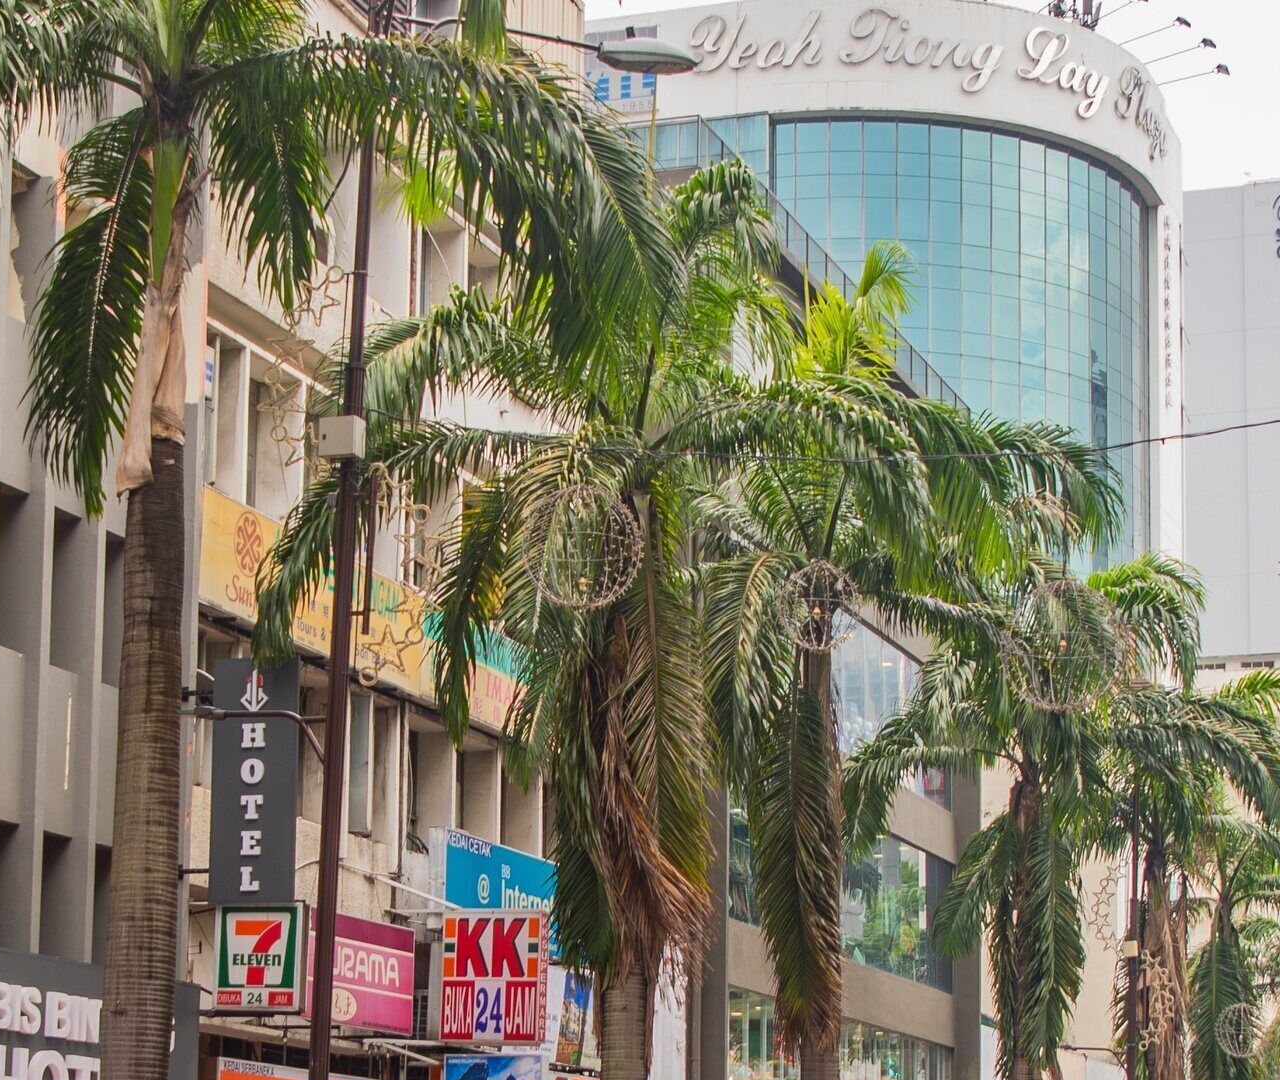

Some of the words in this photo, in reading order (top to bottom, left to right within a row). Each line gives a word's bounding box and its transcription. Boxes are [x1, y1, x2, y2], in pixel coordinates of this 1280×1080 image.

[687, 8, 824, 73] Yeoh
[839, 7, 1004, 93] Tiong
[1017, 26, 1110, 120] Lay
[239, 722, 266, 893] HOTEL
[446, 829, 468, 851] KEDAI
[468, 837, 492, 858] CETAK
[501, 863, 511, 880] BB
[455, 916, 528, 978] KK
[246, 992, 263, 1007] 24
[273, 994, 288, 1005] JAM
[443, 984, 474, 1040] BUKA
[474, 985, 503, 1035] 24
[504, 985, 536, 1040] JAM
[223, 1060, 241, 1072] KEDAI
